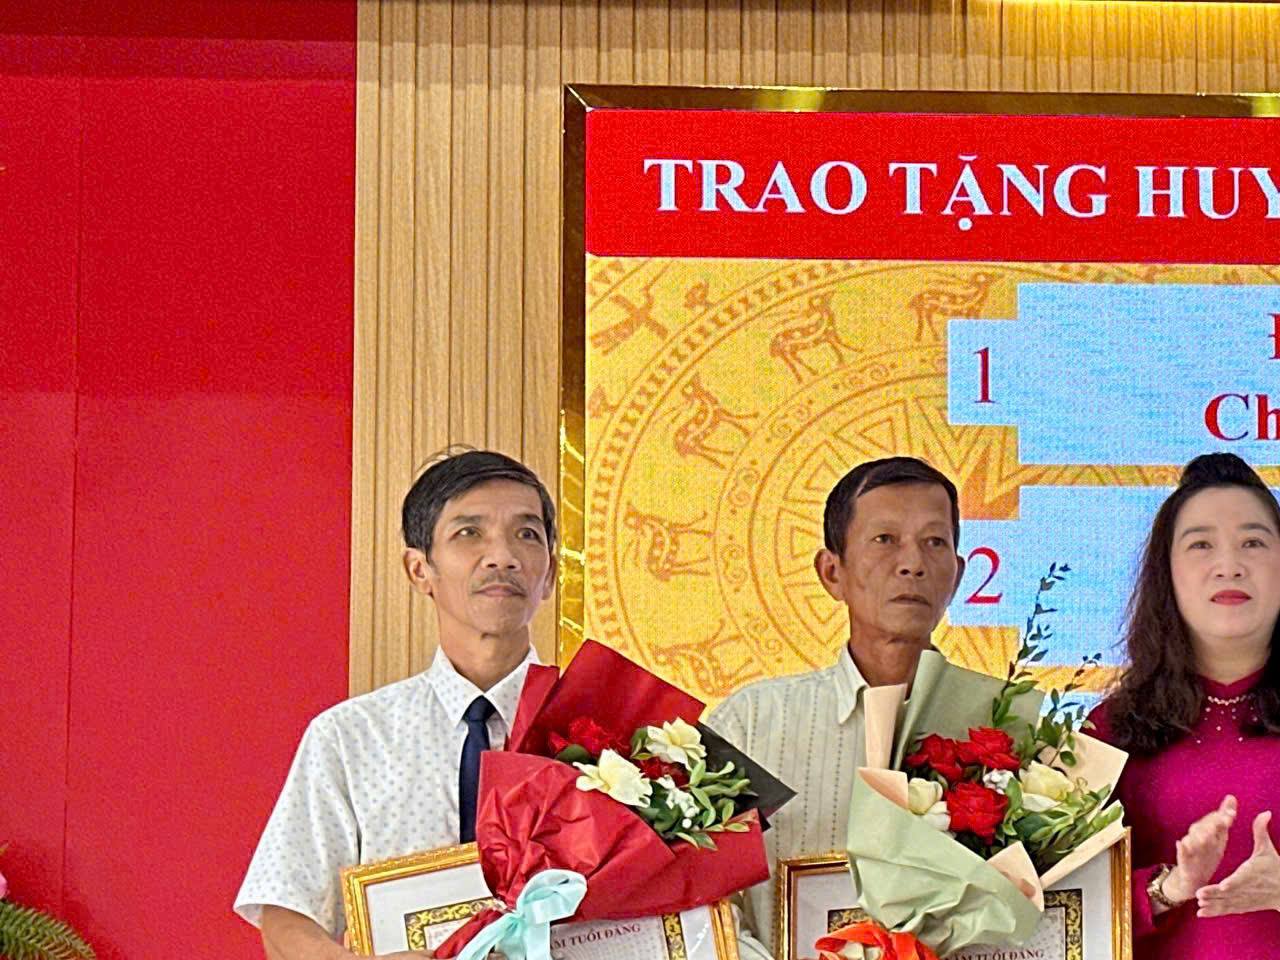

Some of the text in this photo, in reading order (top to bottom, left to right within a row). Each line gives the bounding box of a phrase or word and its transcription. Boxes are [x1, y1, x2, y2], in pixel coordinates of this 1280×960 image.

[643, 158, 868, 215] TRAO
[889, 154, 1110, 231] TẶNG
[974, 347, 996, 403] 1
[965, 546, 1003, 603] 2
